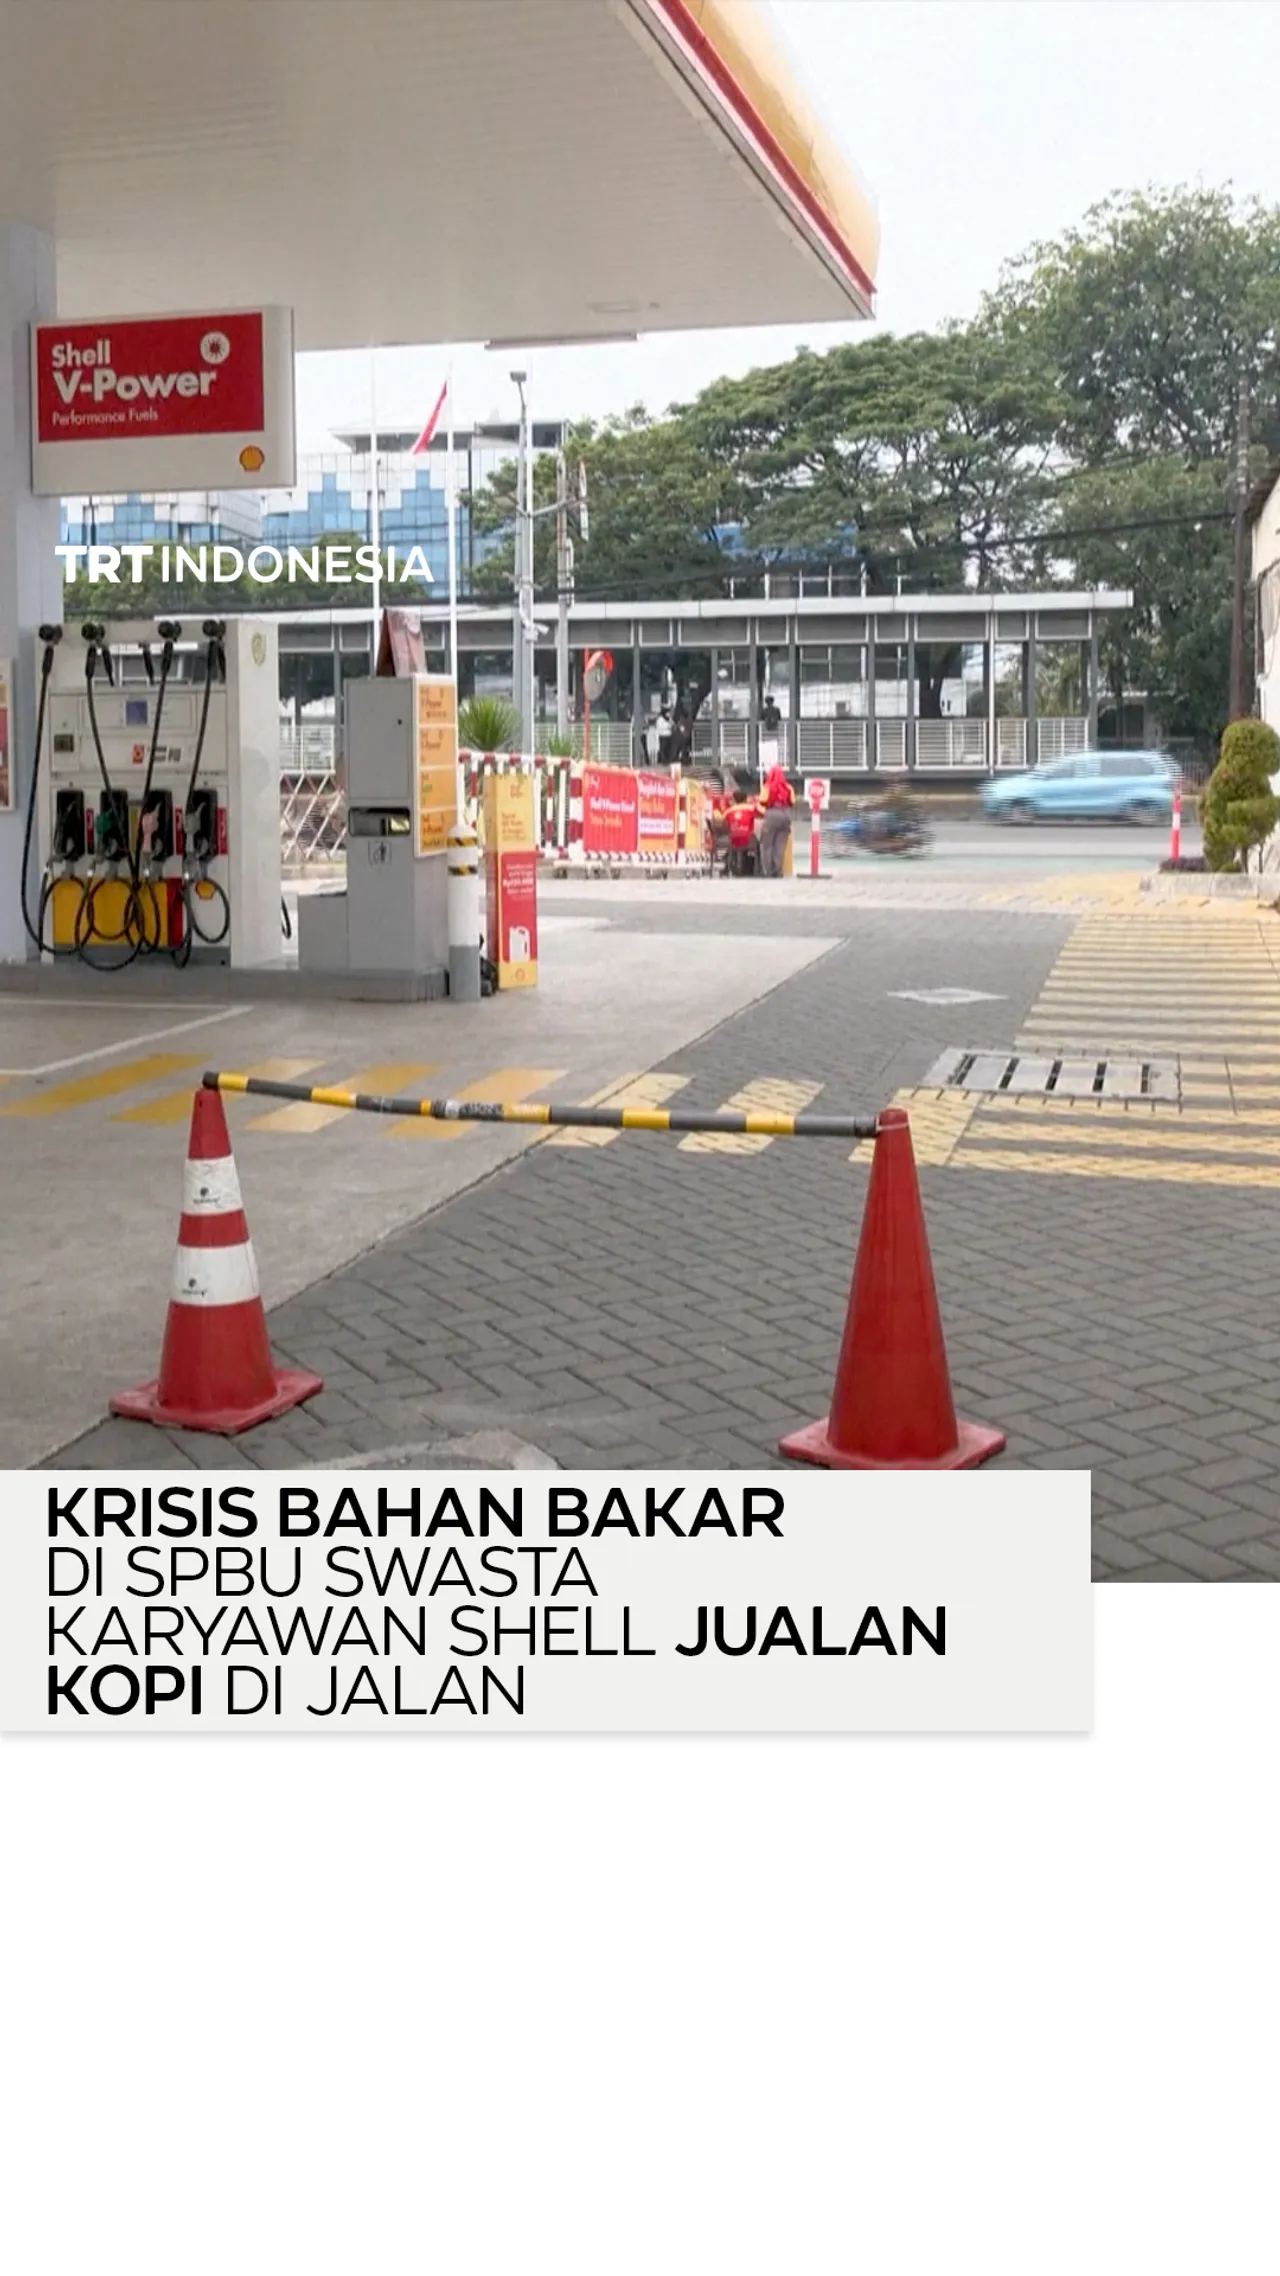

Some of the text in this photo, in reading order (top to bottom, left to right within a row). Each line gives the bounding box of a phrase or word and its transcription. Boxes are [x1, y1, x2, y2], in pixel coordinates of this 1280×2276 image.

[52, 339, 111, 368] Shell
[53, 368, 217, 404] V-Power
[52, 406, 158, 426] Performance Fuels
